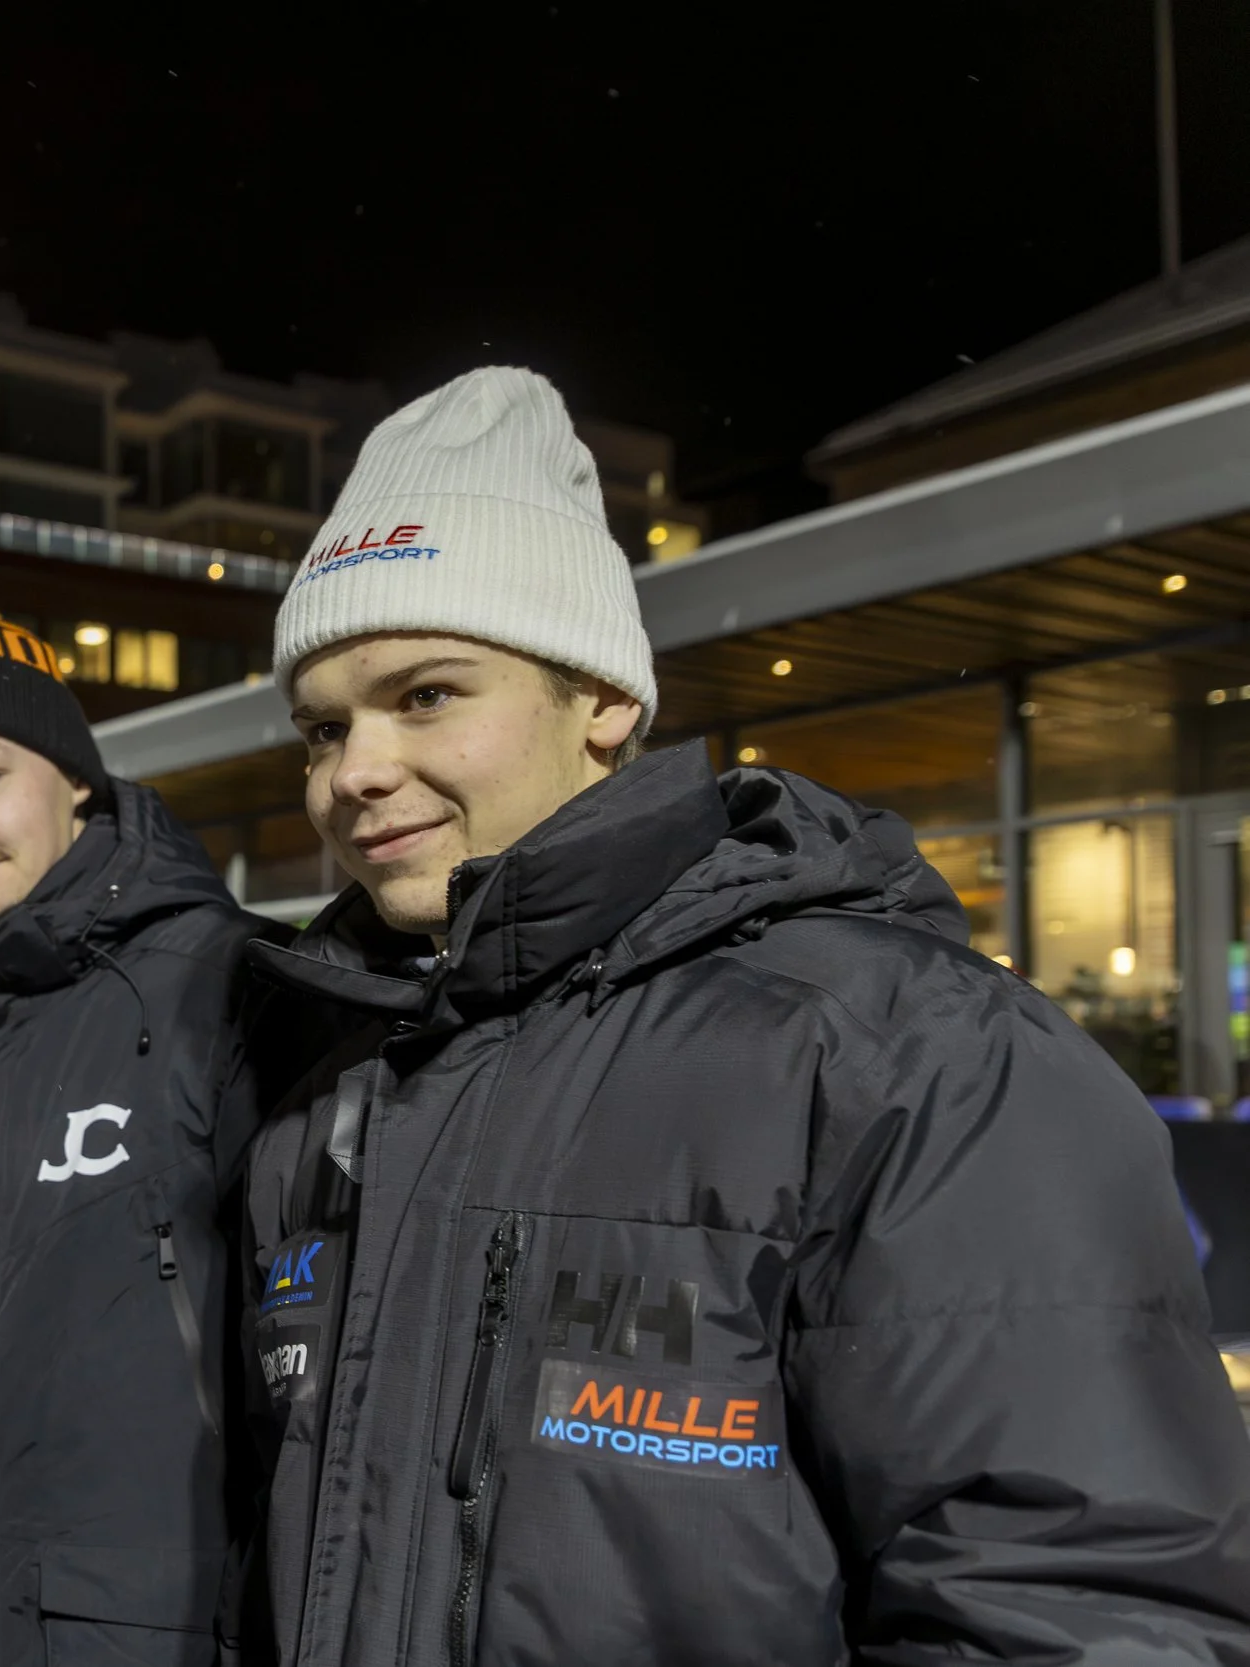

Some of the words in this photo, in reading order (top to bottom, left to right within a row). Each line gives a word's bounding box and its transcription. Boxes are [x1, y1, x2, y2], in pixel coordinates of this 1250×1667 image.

[37, 1103, 132, 1182] JC
[570, 1380, 760, 1440] MILLE
[539, 1415, 780, 1469] MOTORSPORT
